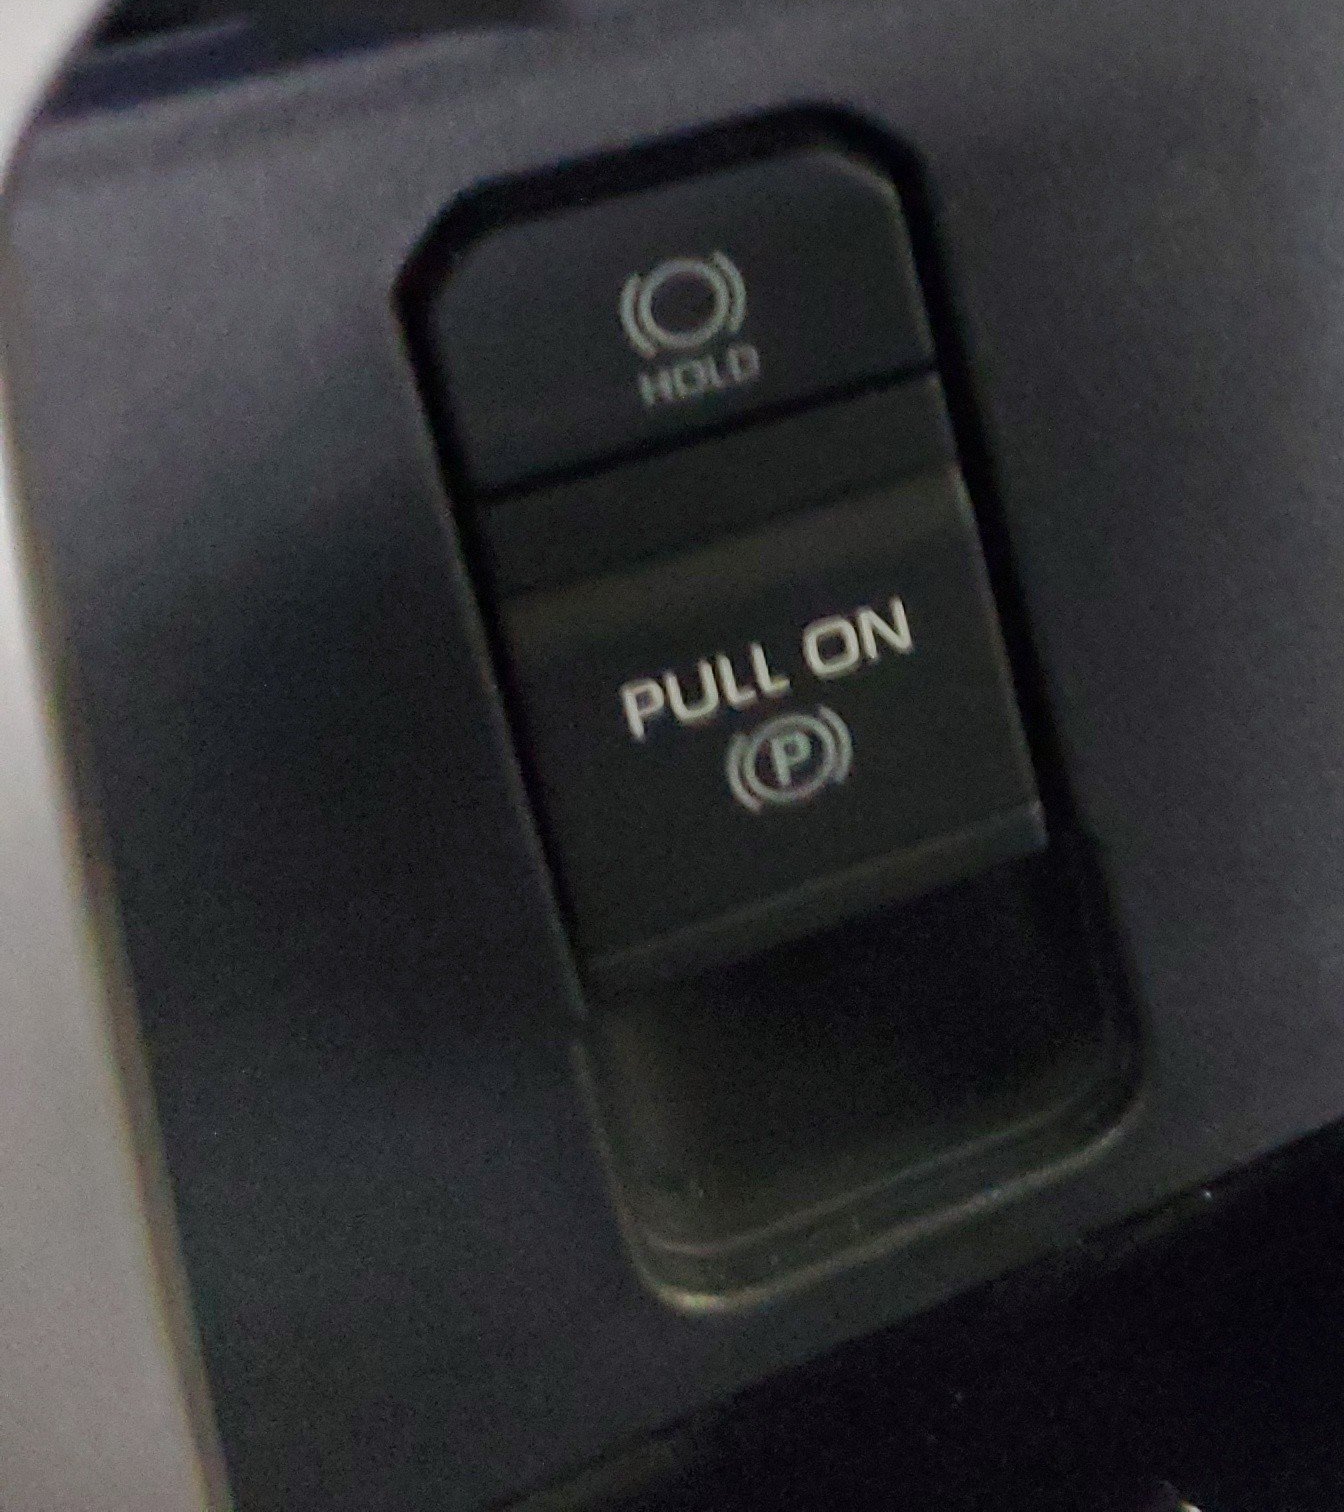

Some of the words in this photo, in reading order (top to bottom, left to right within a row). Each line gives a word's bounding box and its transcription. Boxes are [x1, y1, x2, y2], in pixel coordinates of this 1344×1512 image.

[638, 343, 761, 407] HOLD
[619, 641, 792, 742] PULL
[802, 595, 915, 680] ON
